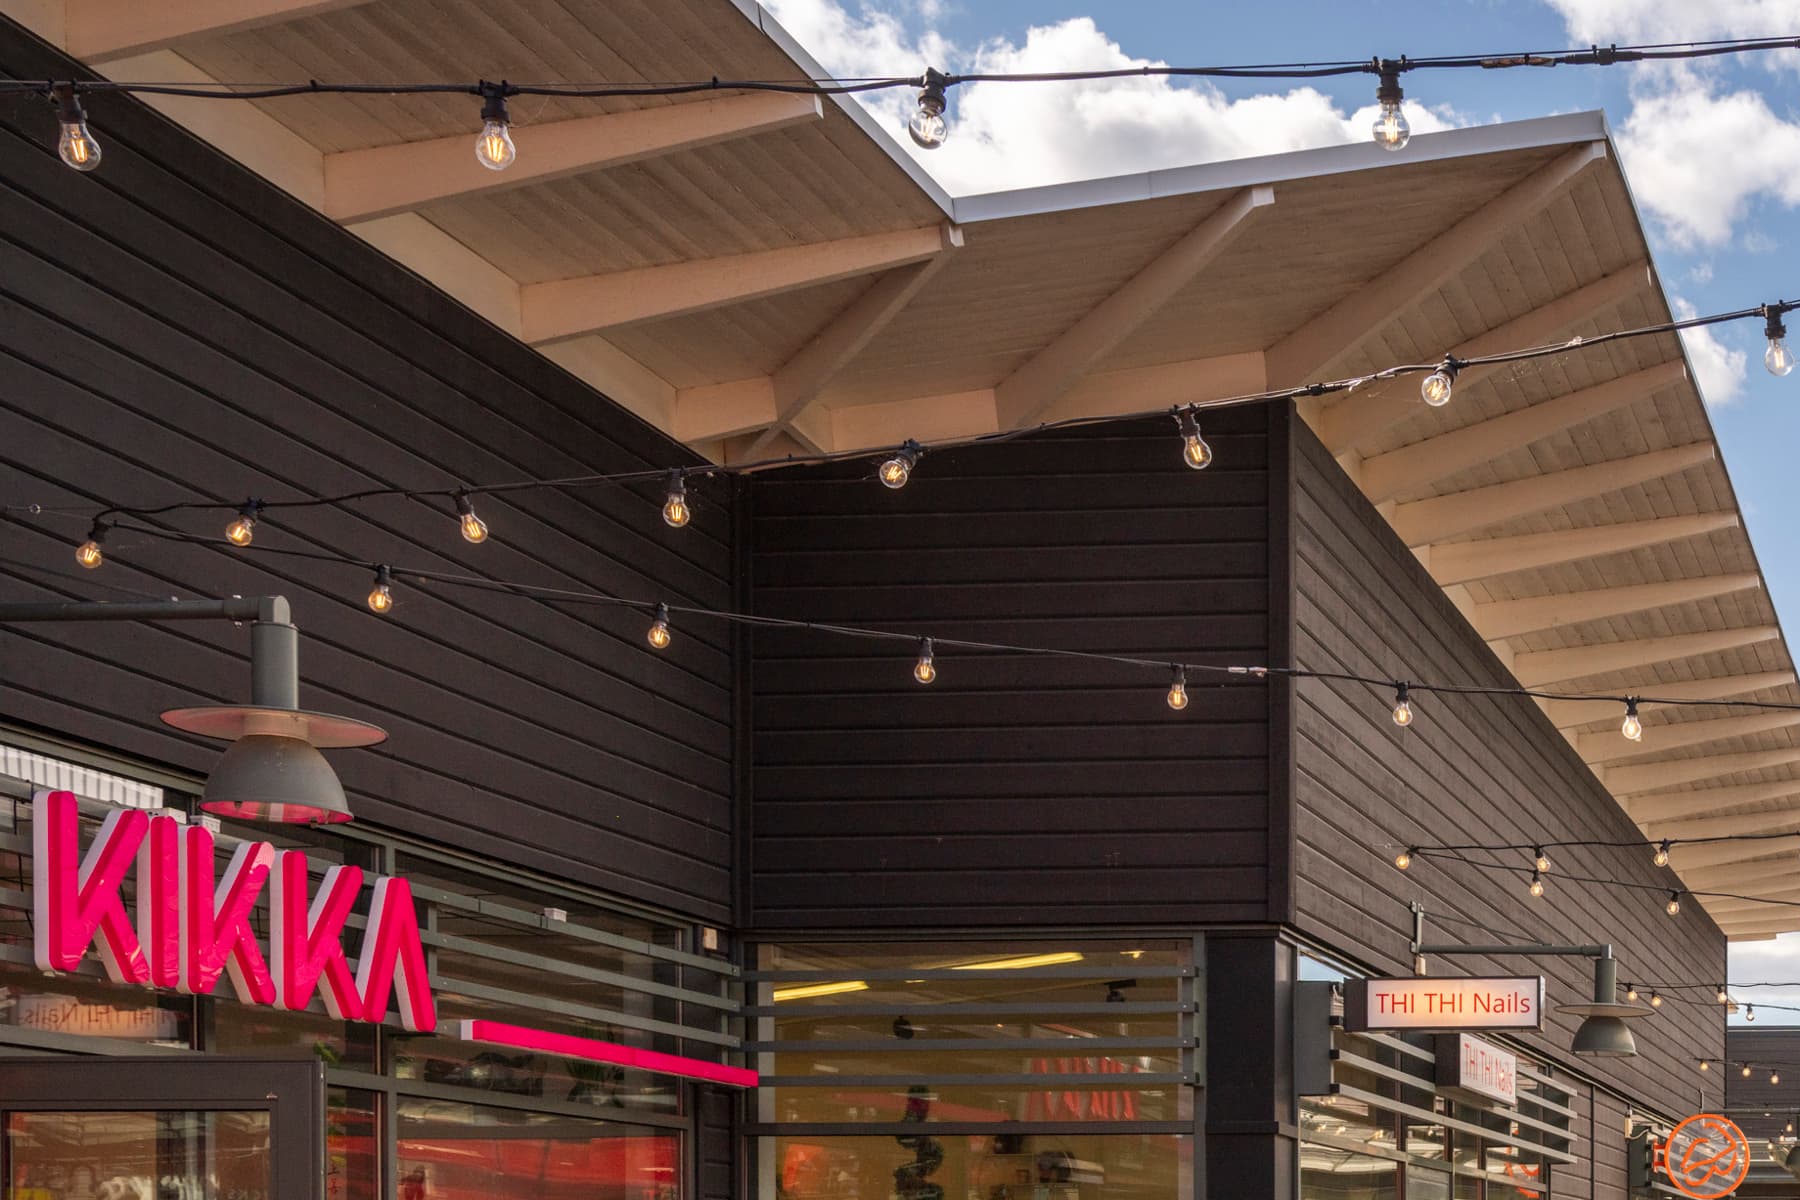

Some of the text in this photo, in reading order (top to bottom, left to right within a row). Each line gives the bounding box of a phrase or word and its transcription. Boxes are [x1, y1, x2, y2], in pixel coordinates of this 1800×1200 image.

[1376, 991, 1531, 1014] THI THI Nails
[1464, 1043, 1478, 1081] THI
[1480, 1050, 1493, 1086] THI
